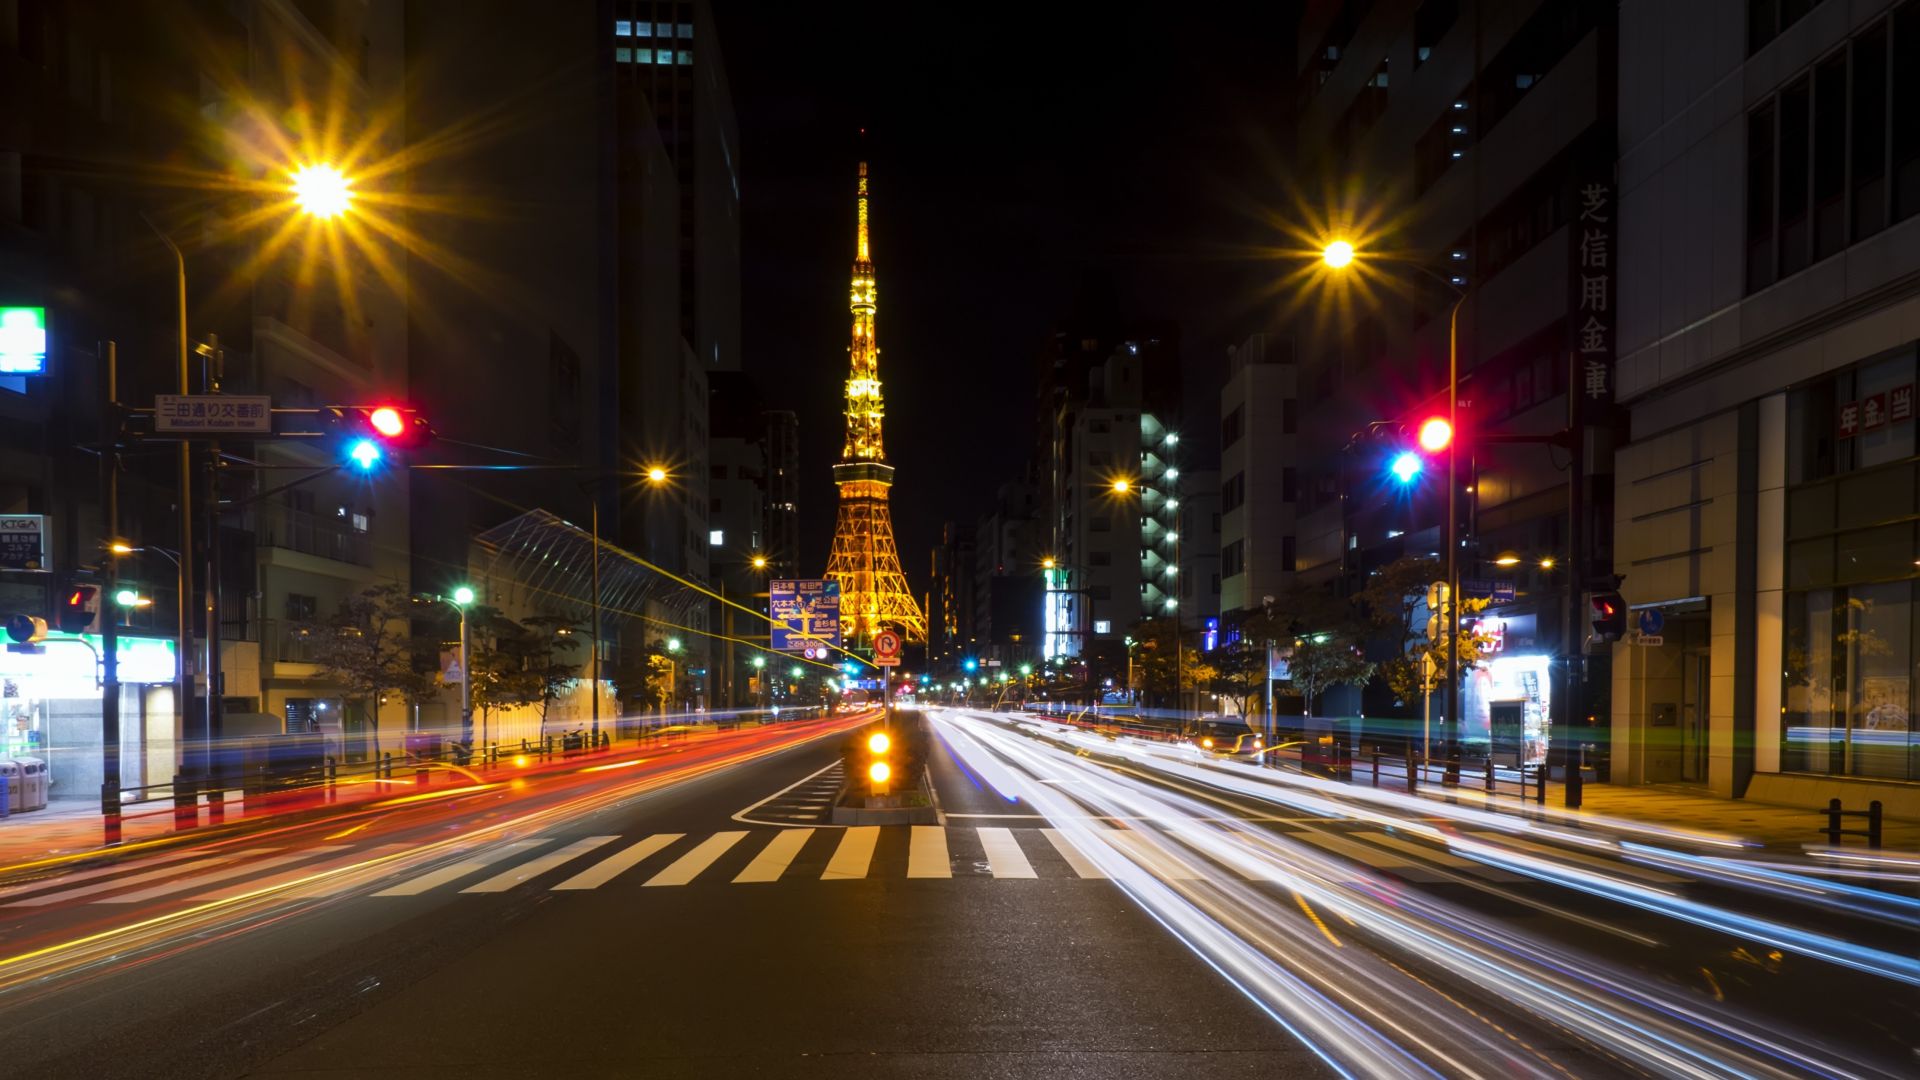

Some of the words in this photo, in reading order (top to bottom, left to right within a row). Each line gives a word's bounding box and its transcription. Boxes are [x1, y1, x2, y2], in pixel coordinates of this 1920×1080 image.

[1579, 182, 1609, 400] 芝信用金庫
[161, 402, 264, 418] 三田通り交番前
[207, 418, 234, 427] Koban
[0, 519, 38, 529] KTGA
[7, 543, 32, 552] ゴルフ
